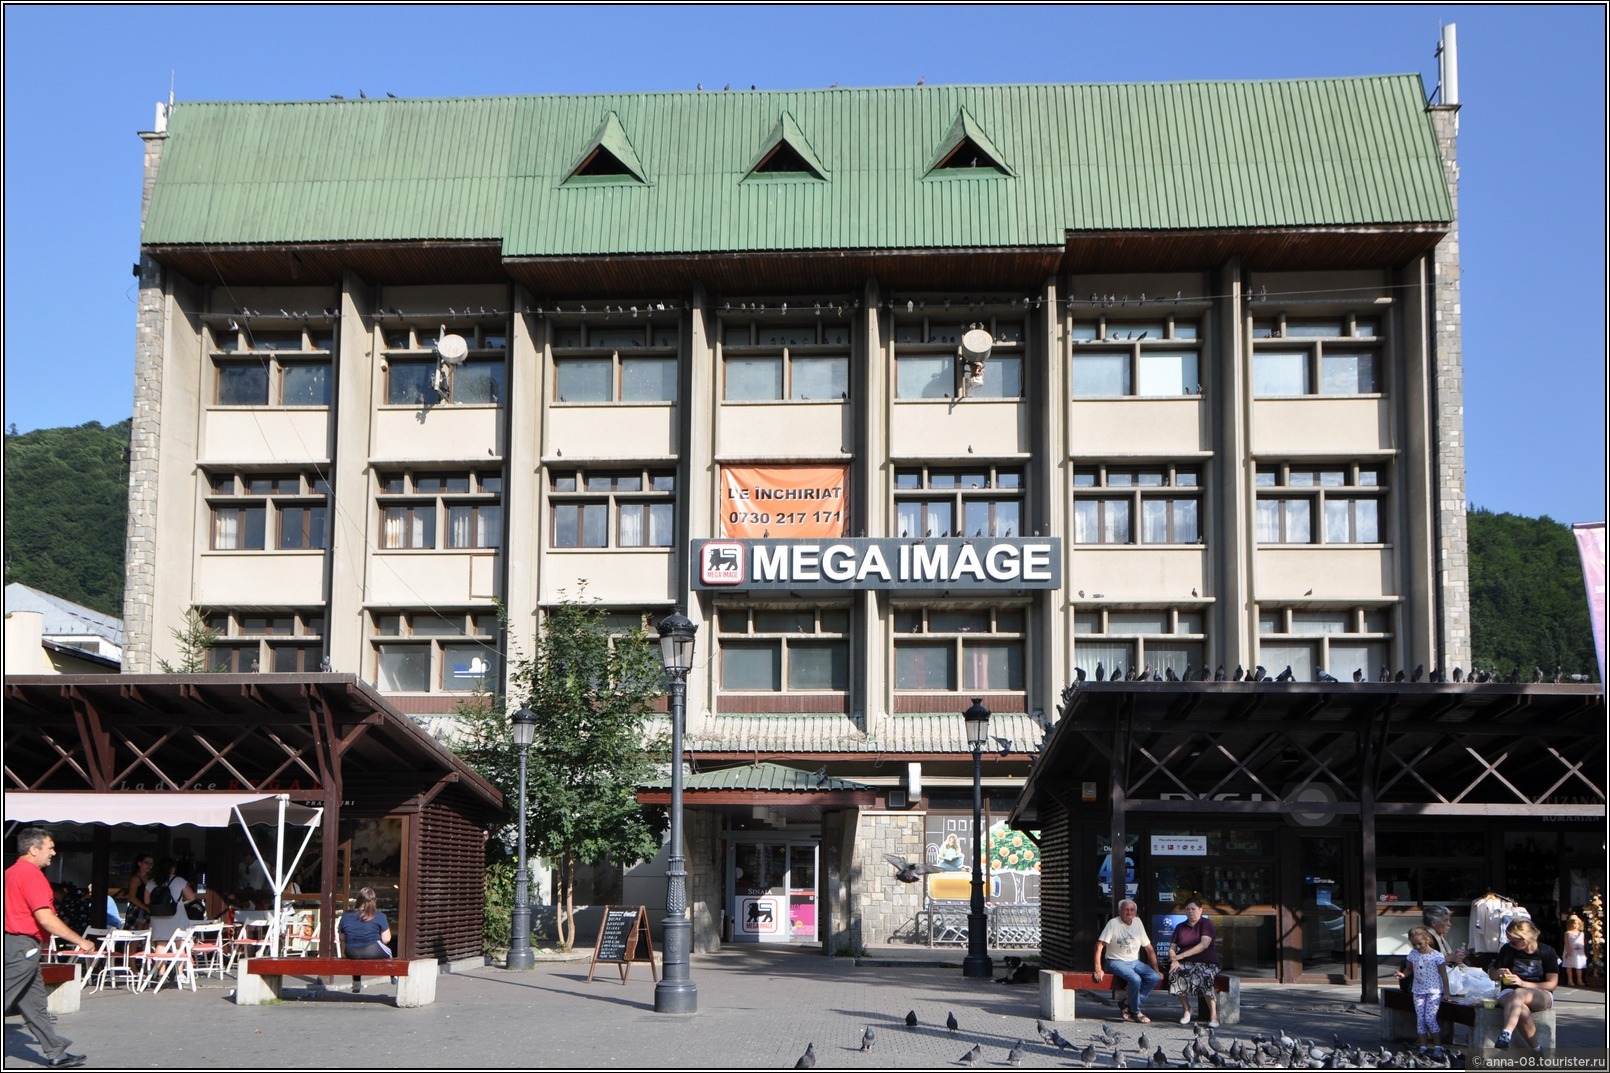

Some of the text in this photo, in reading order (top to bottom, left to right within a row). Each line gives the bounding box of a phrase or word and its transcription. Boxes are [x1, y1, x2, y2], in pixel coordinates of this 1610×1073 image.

[755, 486, 842, 500] ÎNCHIRIAT
[729, 511, 841, 524] 0730 217 171
[753, 544, 1052, 581] MEGA IMAGE
